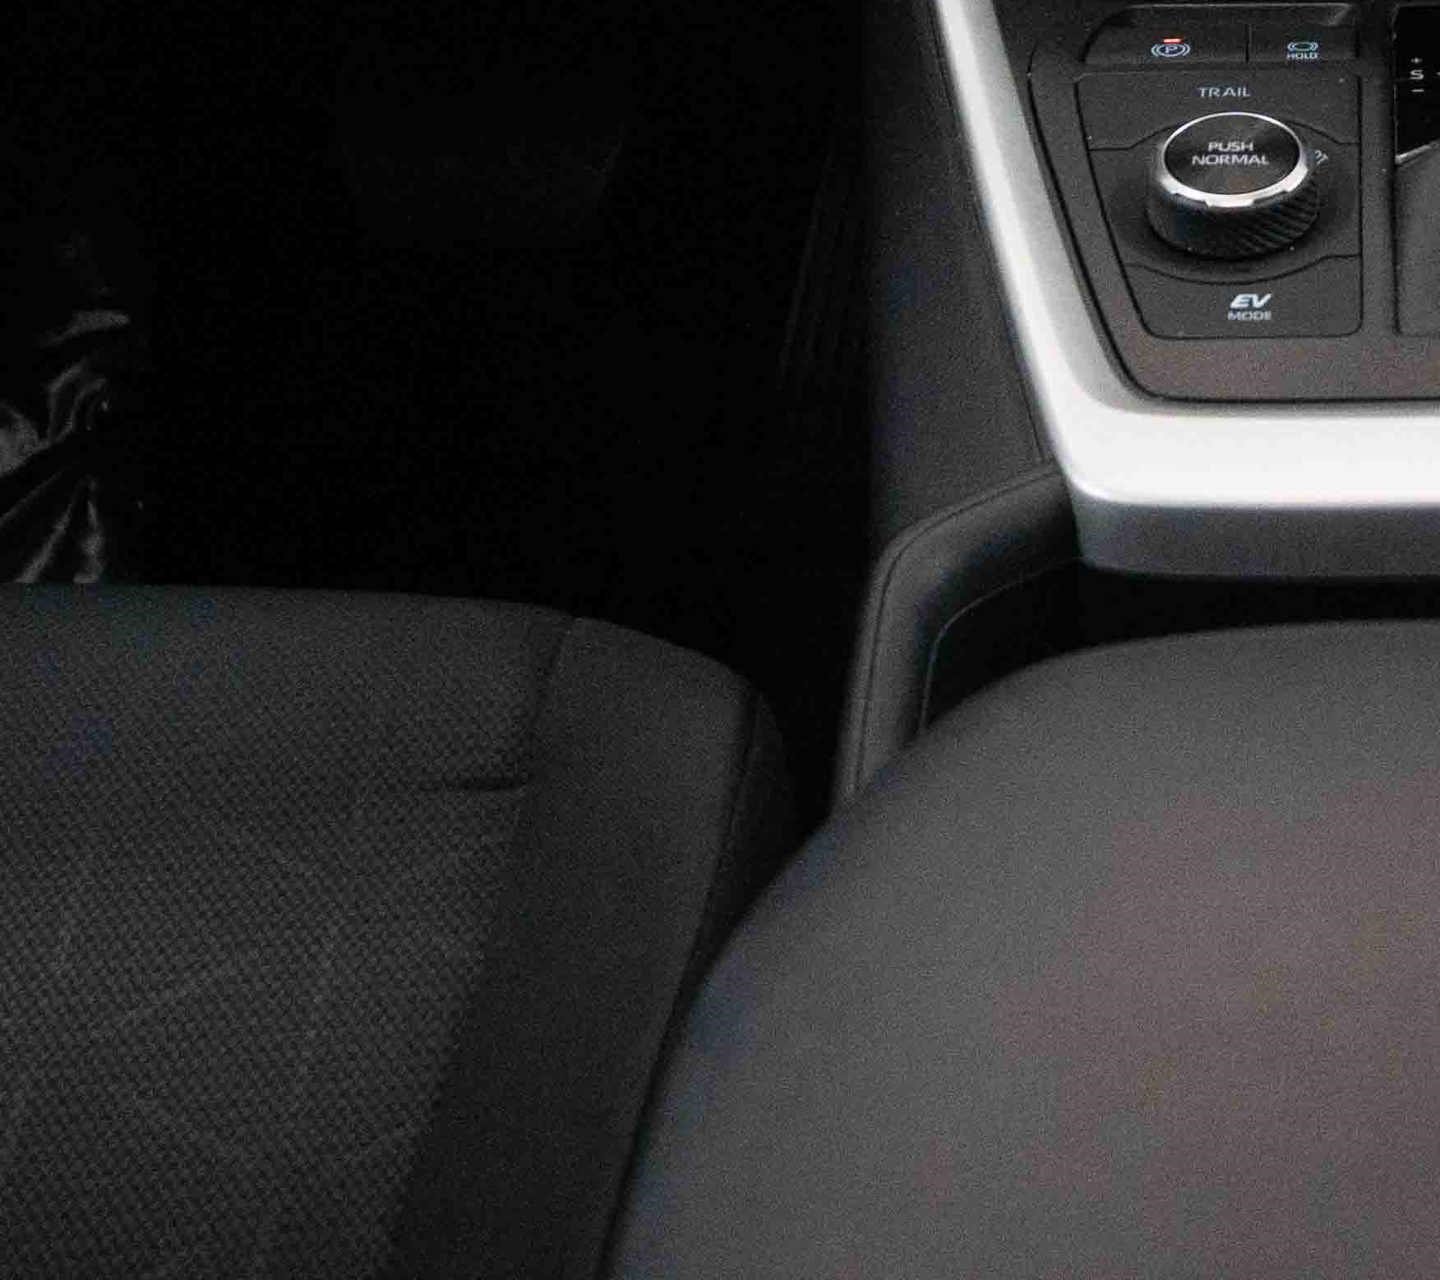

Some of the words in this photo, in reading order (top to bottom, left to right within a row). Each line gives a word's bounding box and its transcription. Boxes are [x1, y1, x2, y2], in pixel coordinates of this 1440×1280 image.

[1286, 52, 1319, 61] HOLD
[1199, 87, 1251, 98] TRAIL
[1208, 141, 1254, 152] PUSH
[1192, 154, 1269, 166] NORMAL
[1230, 293, 1272, 309] EV
[1227, 311, 1272, 321] MODE
